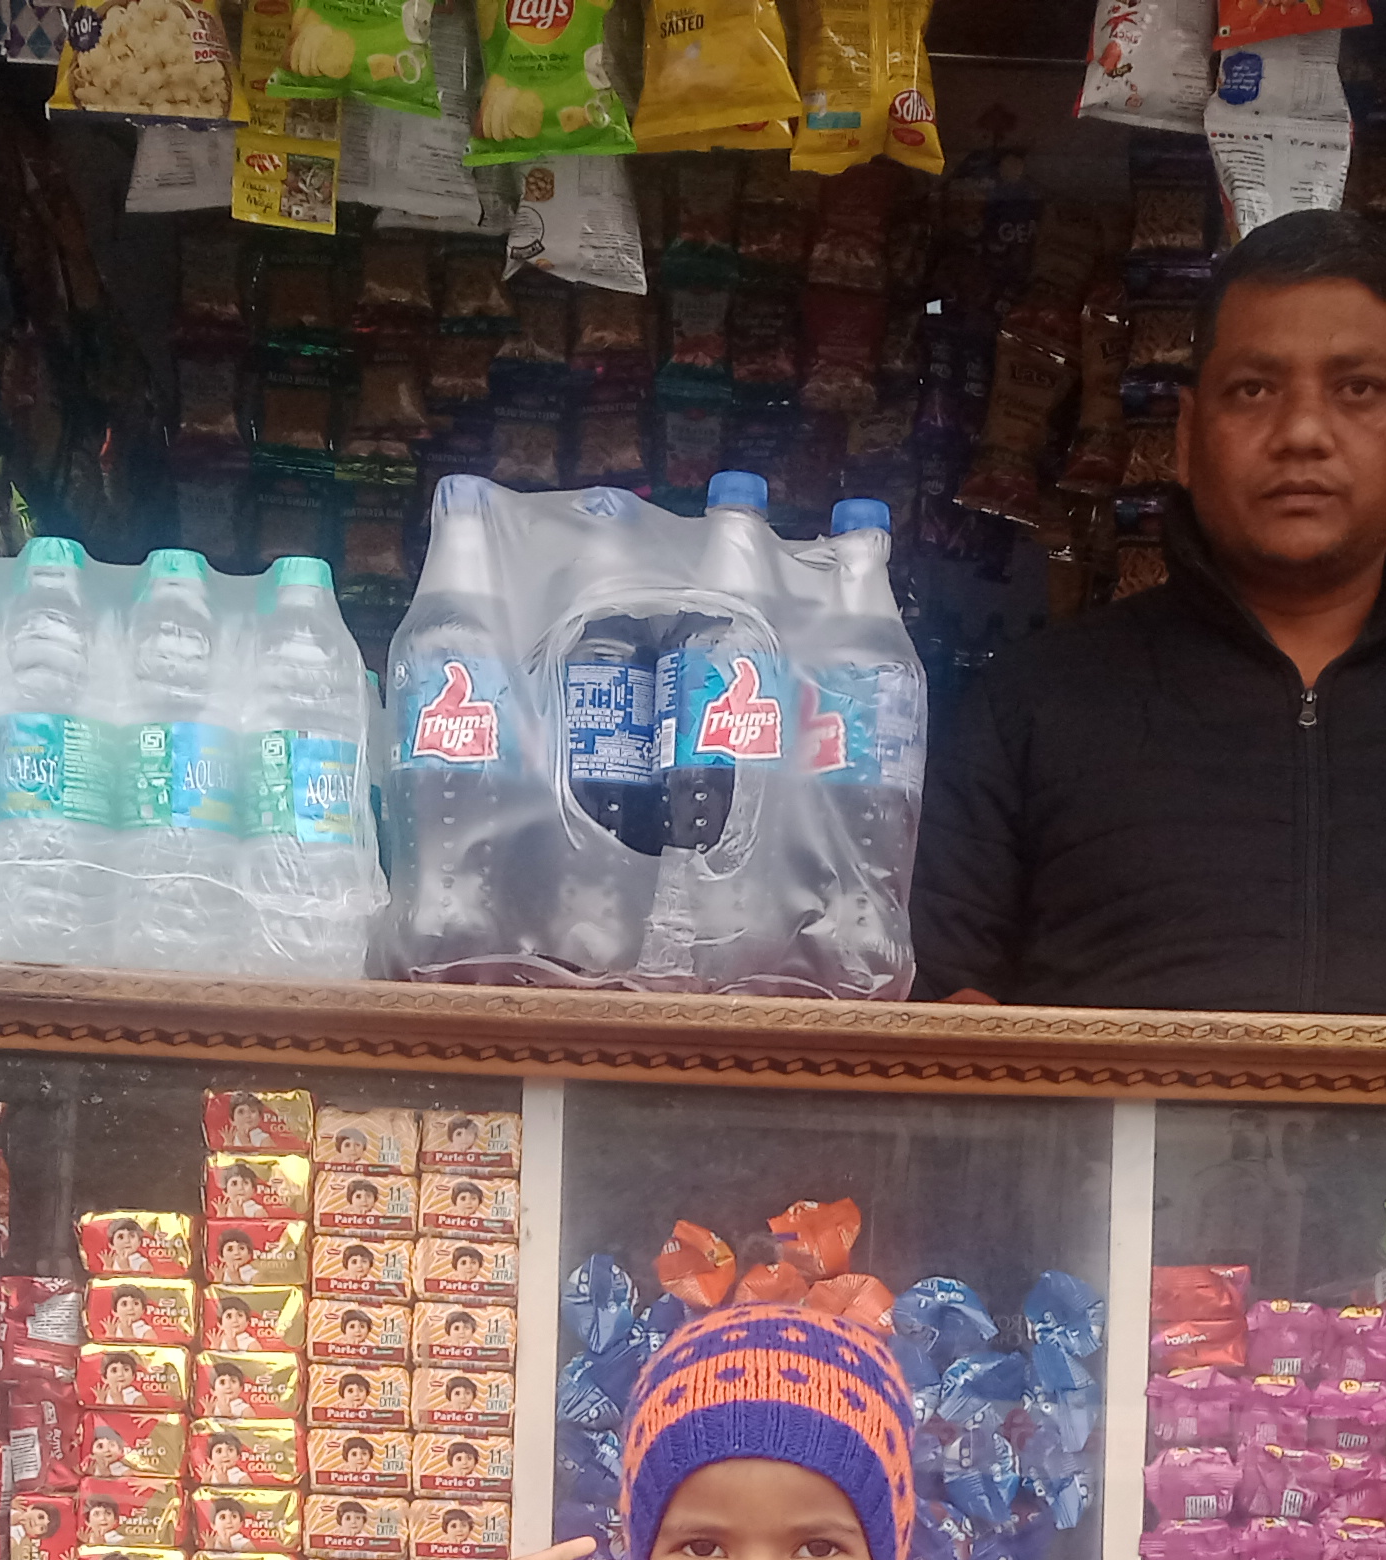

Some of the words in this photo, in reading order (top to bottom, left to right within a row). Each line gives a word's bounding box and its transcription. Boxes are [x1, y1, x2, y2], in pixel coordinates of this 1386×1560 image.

[660, 15, 704, 39] SALTED
[422, 713, 492, 738] Thums
[709, 711, 776, 735] Thums
[435, 1152, 475, 1162] Parle-G
[334, 1214, 375, 1225] Parle-G
[437, 1216, 479, 1227] Parle-G
[329, 1280, 370, 1291] Parle-G
[438, 1280, 480, 1291] Parle-G
[327, 1344, 369, 1355] Parle-G
[432, 1346, 473, 1357] Parle-G
[136, 1372, 179, 1382] Parle-G
[142, 1382, 170, 1392] GOLD
[243, 1384, 287, 1394] Parle-G
[249, 1394, 279, 1404] GOLD
[326, 1409, 367, 1420] Parle-G
[433, 1411, 474, 1422] Parle-G
[241, 1451, 285, 1462] Parle-G
[247, 1462, 277, 1472] GOLD
[330, 1472, 371, 1483] Parle-G
[434, 1477, 475, 1488] Parle-G
[124, 1526, 155, 1536] GOLD
[250, 1528, 279, 1539] GOLD
[324, 1536, 365, 1547] Parle-G
[429, 1544, 471, 1555] Parle-G
